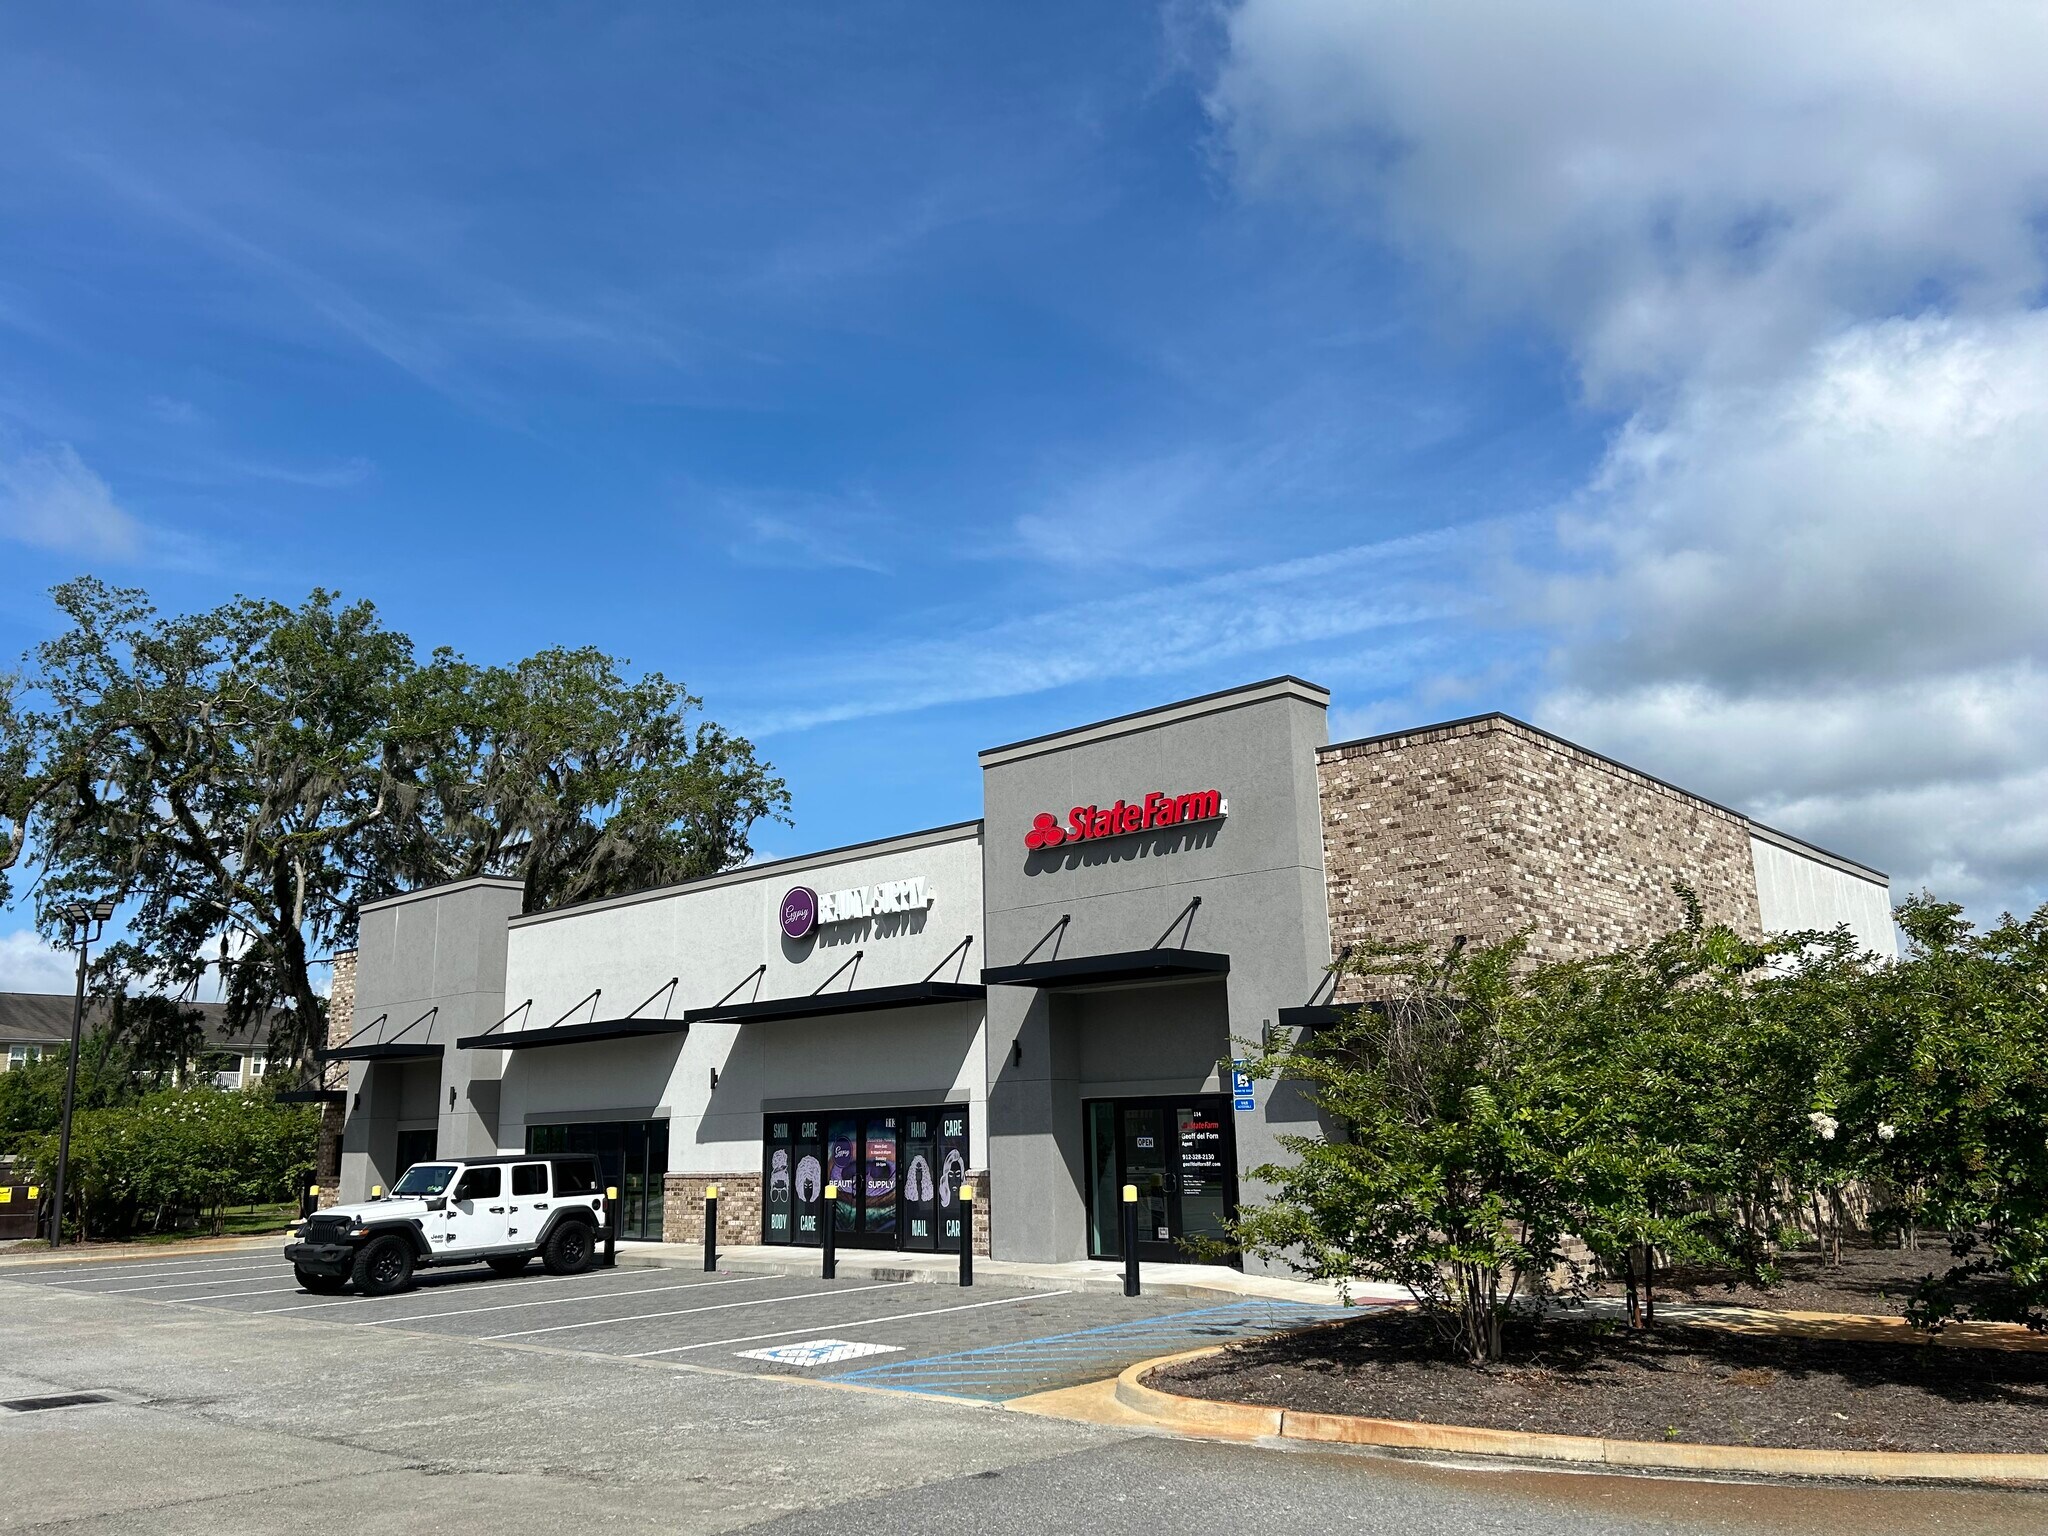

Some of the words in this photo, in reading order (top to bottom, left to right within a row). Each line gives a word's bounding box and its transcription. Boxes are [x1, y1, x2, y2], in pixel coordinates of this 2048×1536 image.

[818, 886, 872, 924] BEAUTY
[874, 876, 927, 914] SUPPLY
[785, 904, 809, 924] Gypsy
[773, 1122, 788, 1138] SKIN
[801, 1122, 817, 1138] CARE
[910, 1121, 927, 1138] HAIR
[944, 1119, 963, 1137] CARE
[1137, 1138, 1153, 1147] OPEN
[868, 1180, 894, 1189] SUPPLY
[771, 1213, 788, 1230] BODY
[800, 1215, 816, 1231] CARE
[911, 1219, 928, 1237] NAIL
[946, 1219, 961, 1237] CAR
